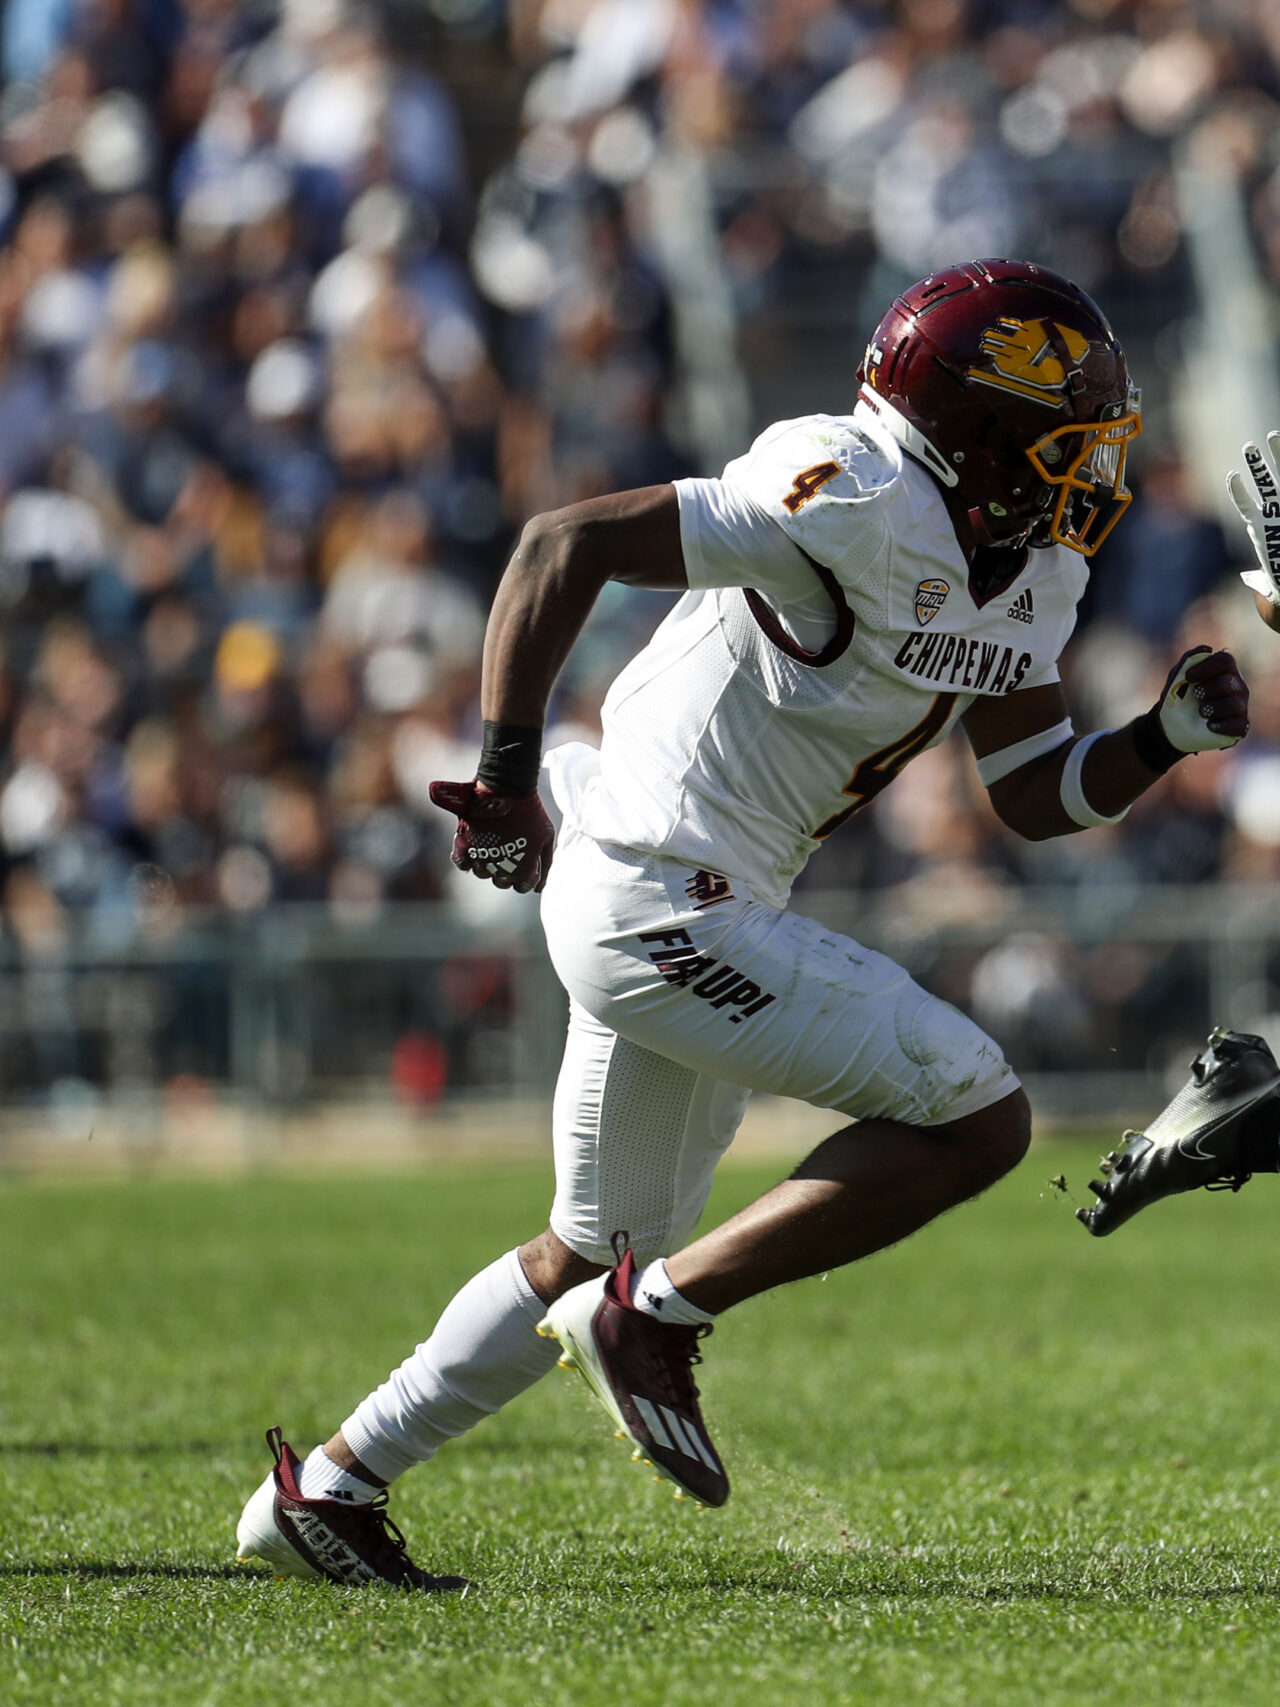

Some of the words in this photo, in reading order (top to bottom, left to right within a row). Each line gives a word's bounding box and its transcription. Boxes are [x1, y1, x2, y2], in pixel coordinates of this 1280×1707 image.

[782, 460, 843, 515] 4
[1007, 607, 1035, 625] adidas
[894, 631, 1033, 694] CHIPPEWAS
[467, 837, 528, 860] adidas
[692, 964, 777, 1024] UP!
